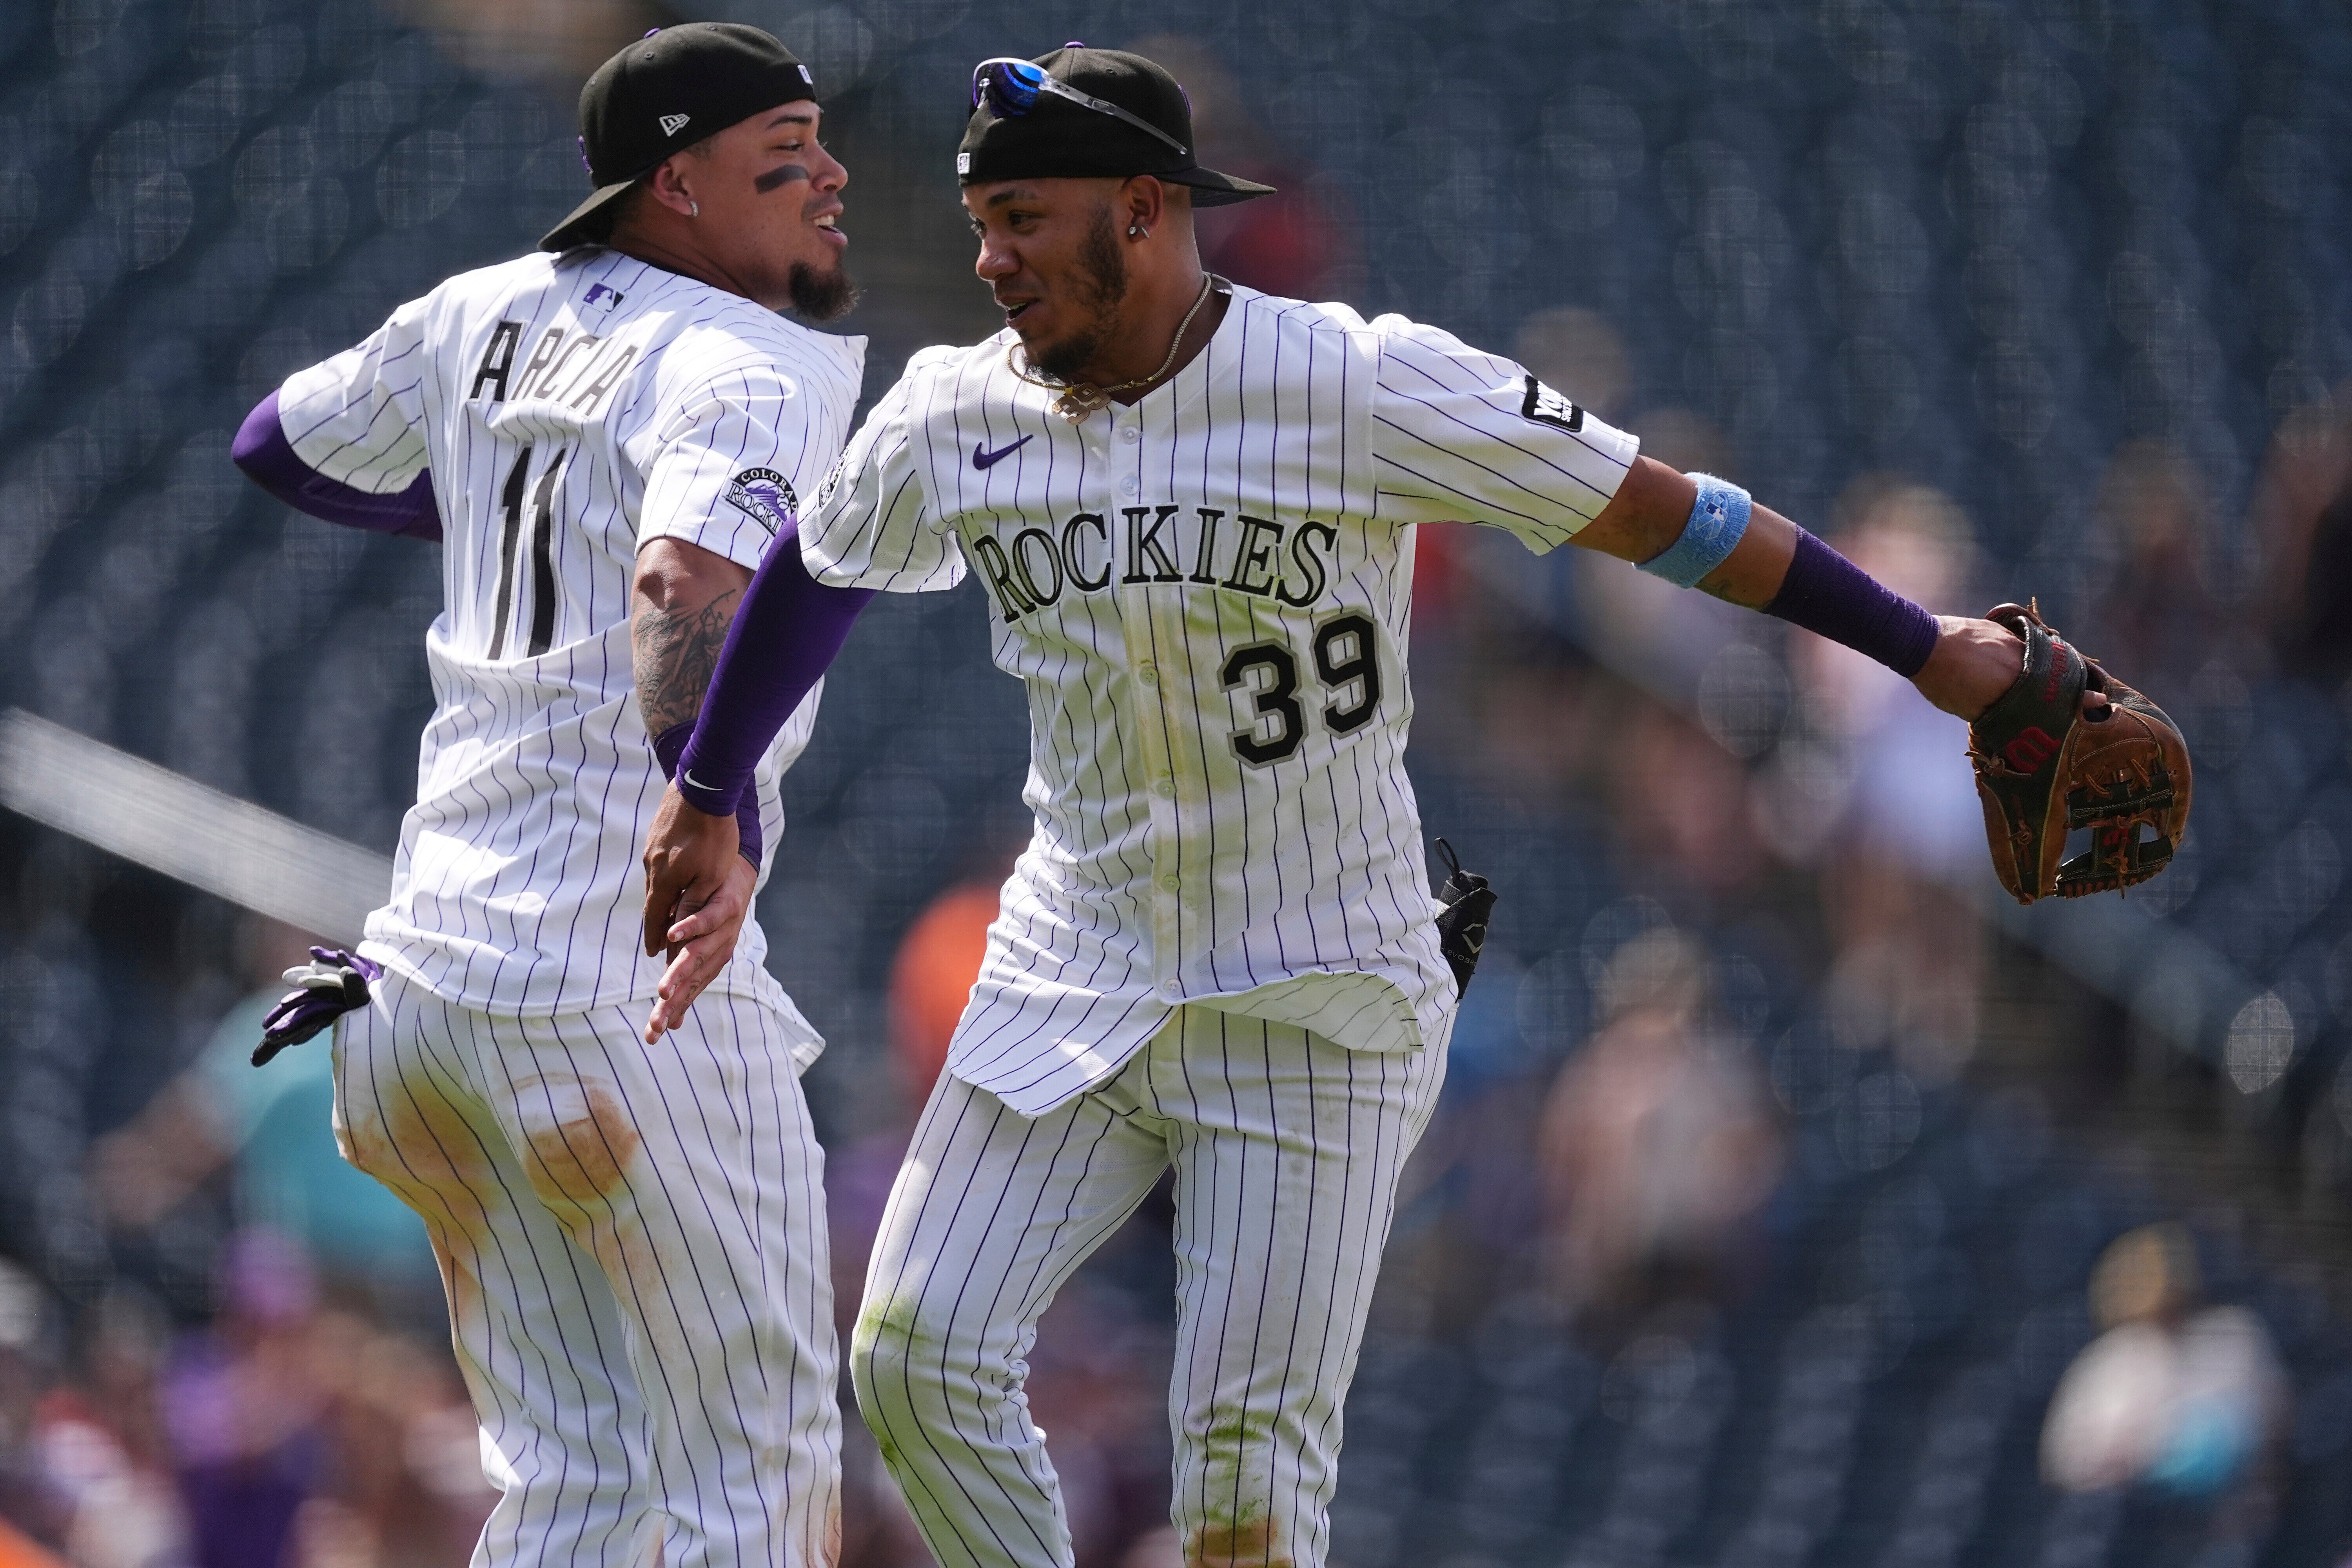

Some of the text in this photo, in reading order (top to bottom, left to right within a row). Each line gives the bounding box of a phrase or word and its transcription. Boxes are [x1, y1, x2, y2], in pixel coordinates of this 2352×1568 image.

[468, 319, 639, 418] ARCIA
[727, 483, 784, 532] ROCKI
[740, 468, 799, 510] COLORAD
[487, 441, 570, 661] 11
[974, 505, 1339, 624] ROCKIES
[1216, 609, 1385, 770] 39
